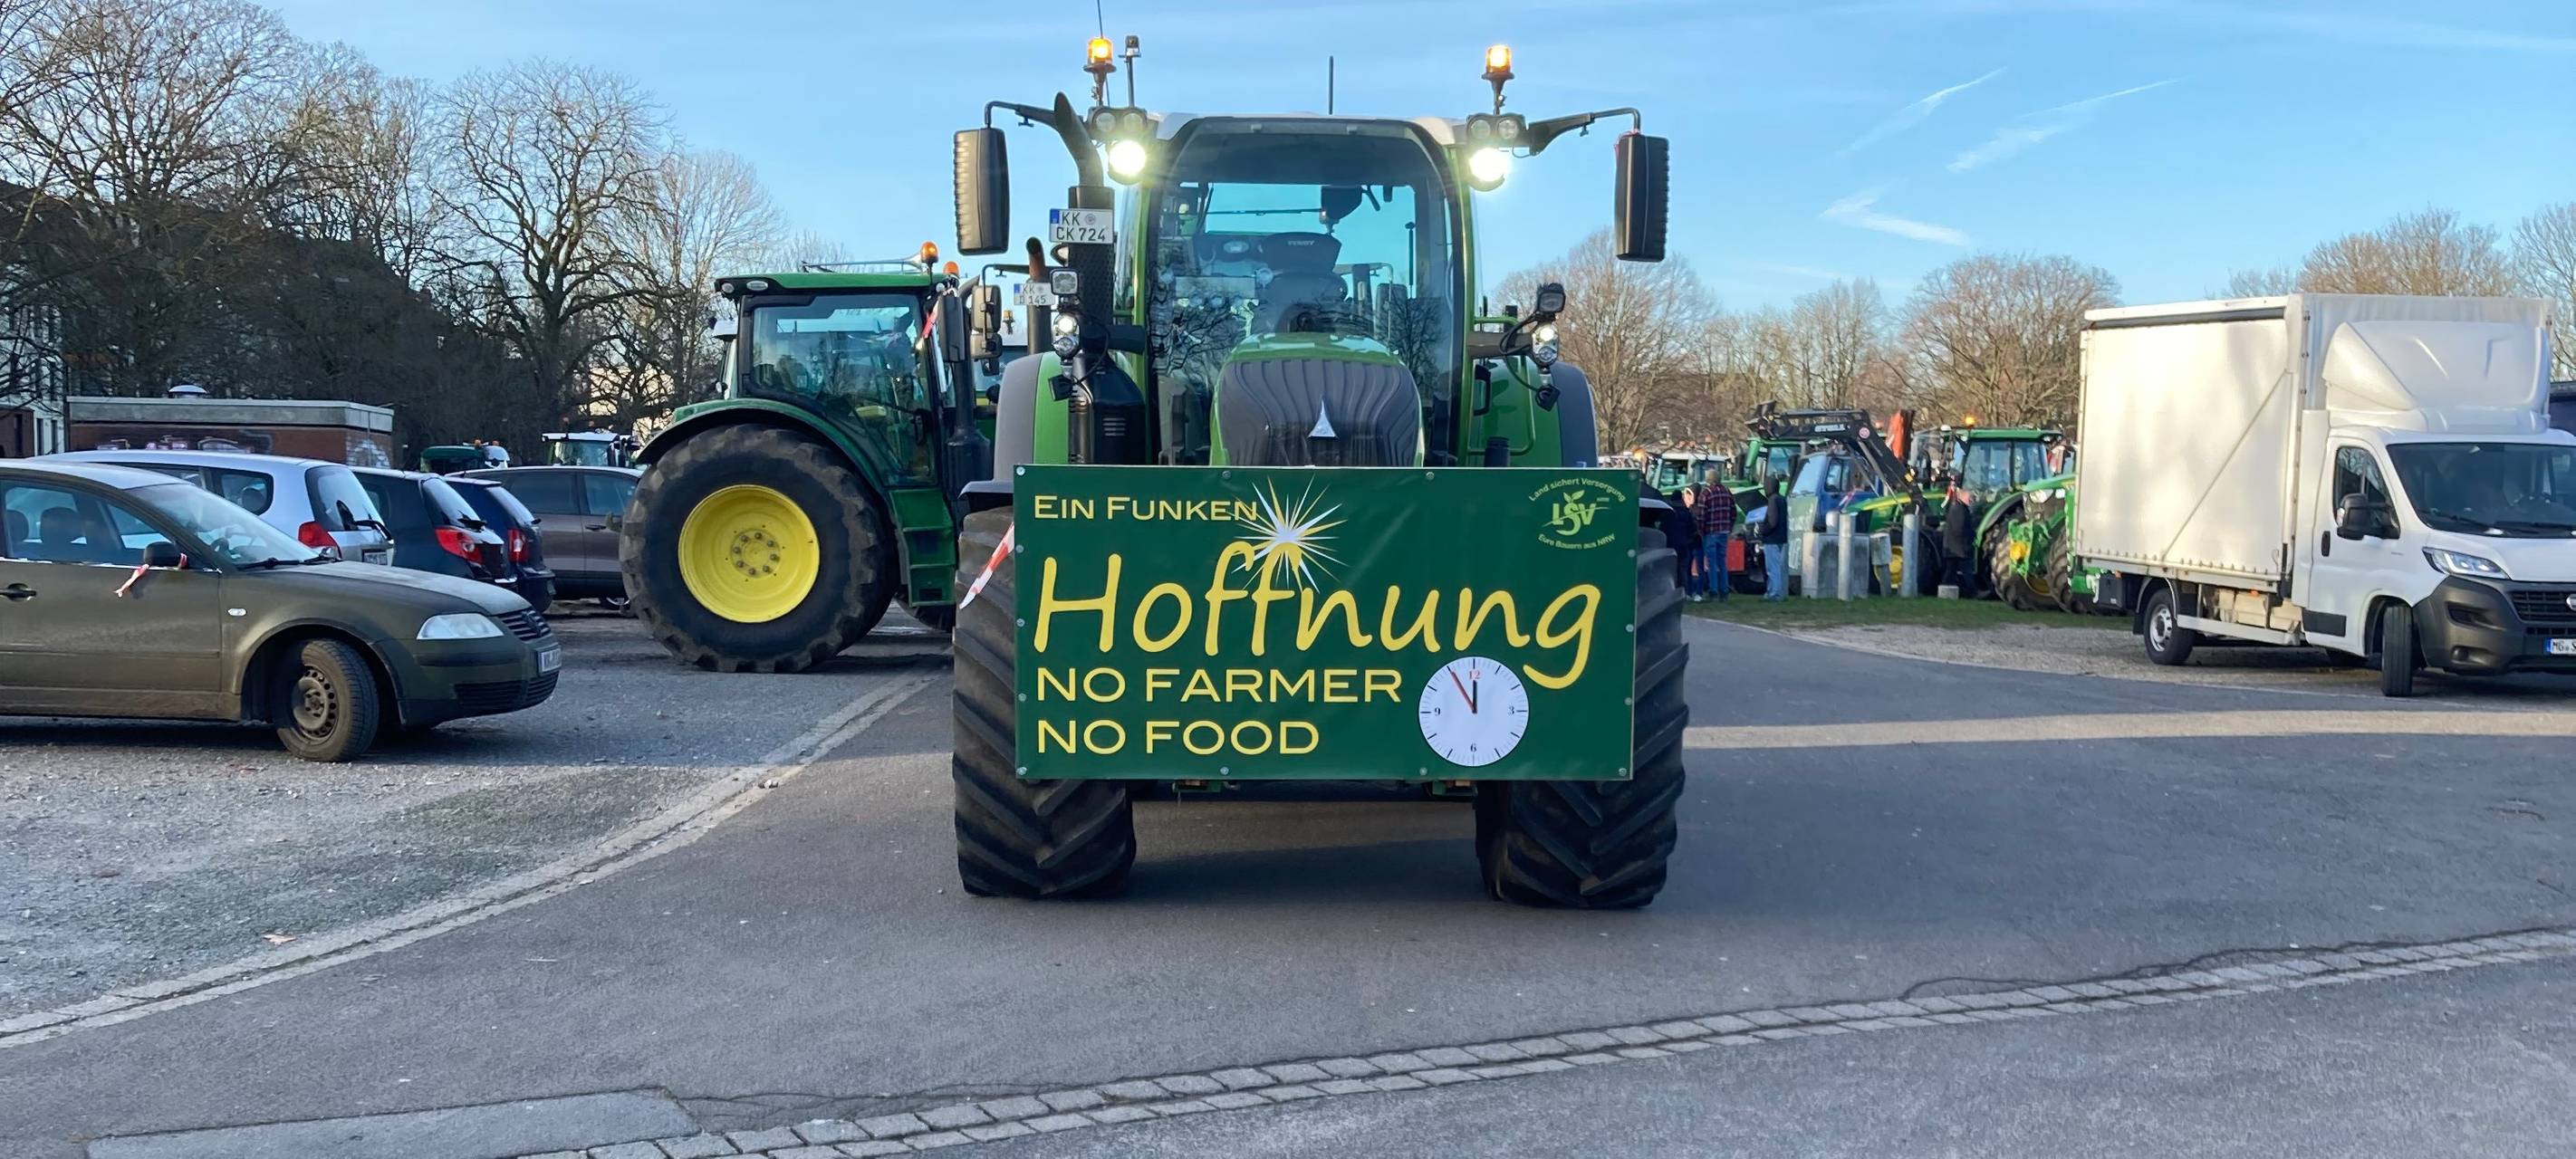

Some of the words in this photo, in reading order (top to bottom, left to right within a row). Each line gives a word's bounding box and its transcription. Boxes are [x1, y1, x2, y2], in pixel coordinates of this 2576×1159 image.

[1062, 212, 1080, 225] KK
[1056, 226, 1075, 241] CK
[1079, 228, 1106, 242] 724
[1023, 284, 1035, 294] KK
[1029, 295, 1046, 305] 145
[1528, 484, 1550, 502] Land
[1550, 477, 1580, 490] sichert
[1581, 477, 1627, 503] Versorgung
[1552, 502, 1597, 536] LSV
[1538, 533, 1555, 546] Eure
[1555, 541, 1582, 550] Bauern
[1583, 541, 1597, 550] aus
[1597, 532, 1616, 547] NRW
[1033, 541, 1601, 689] Hoffnung
[1468, 670, 1481, 680] 12
[1037, 667, 1126, 703] NO
[1146, 668, 1402, 703] FARMER
[1434, 707, 1441, 716] 9
[1508, 705, 1515, 715] 3
[1038, 719, 1126, 754] NO
[1146, 720, 1319, 755] FOOD
[1470, 743, 1477, 752] 6
